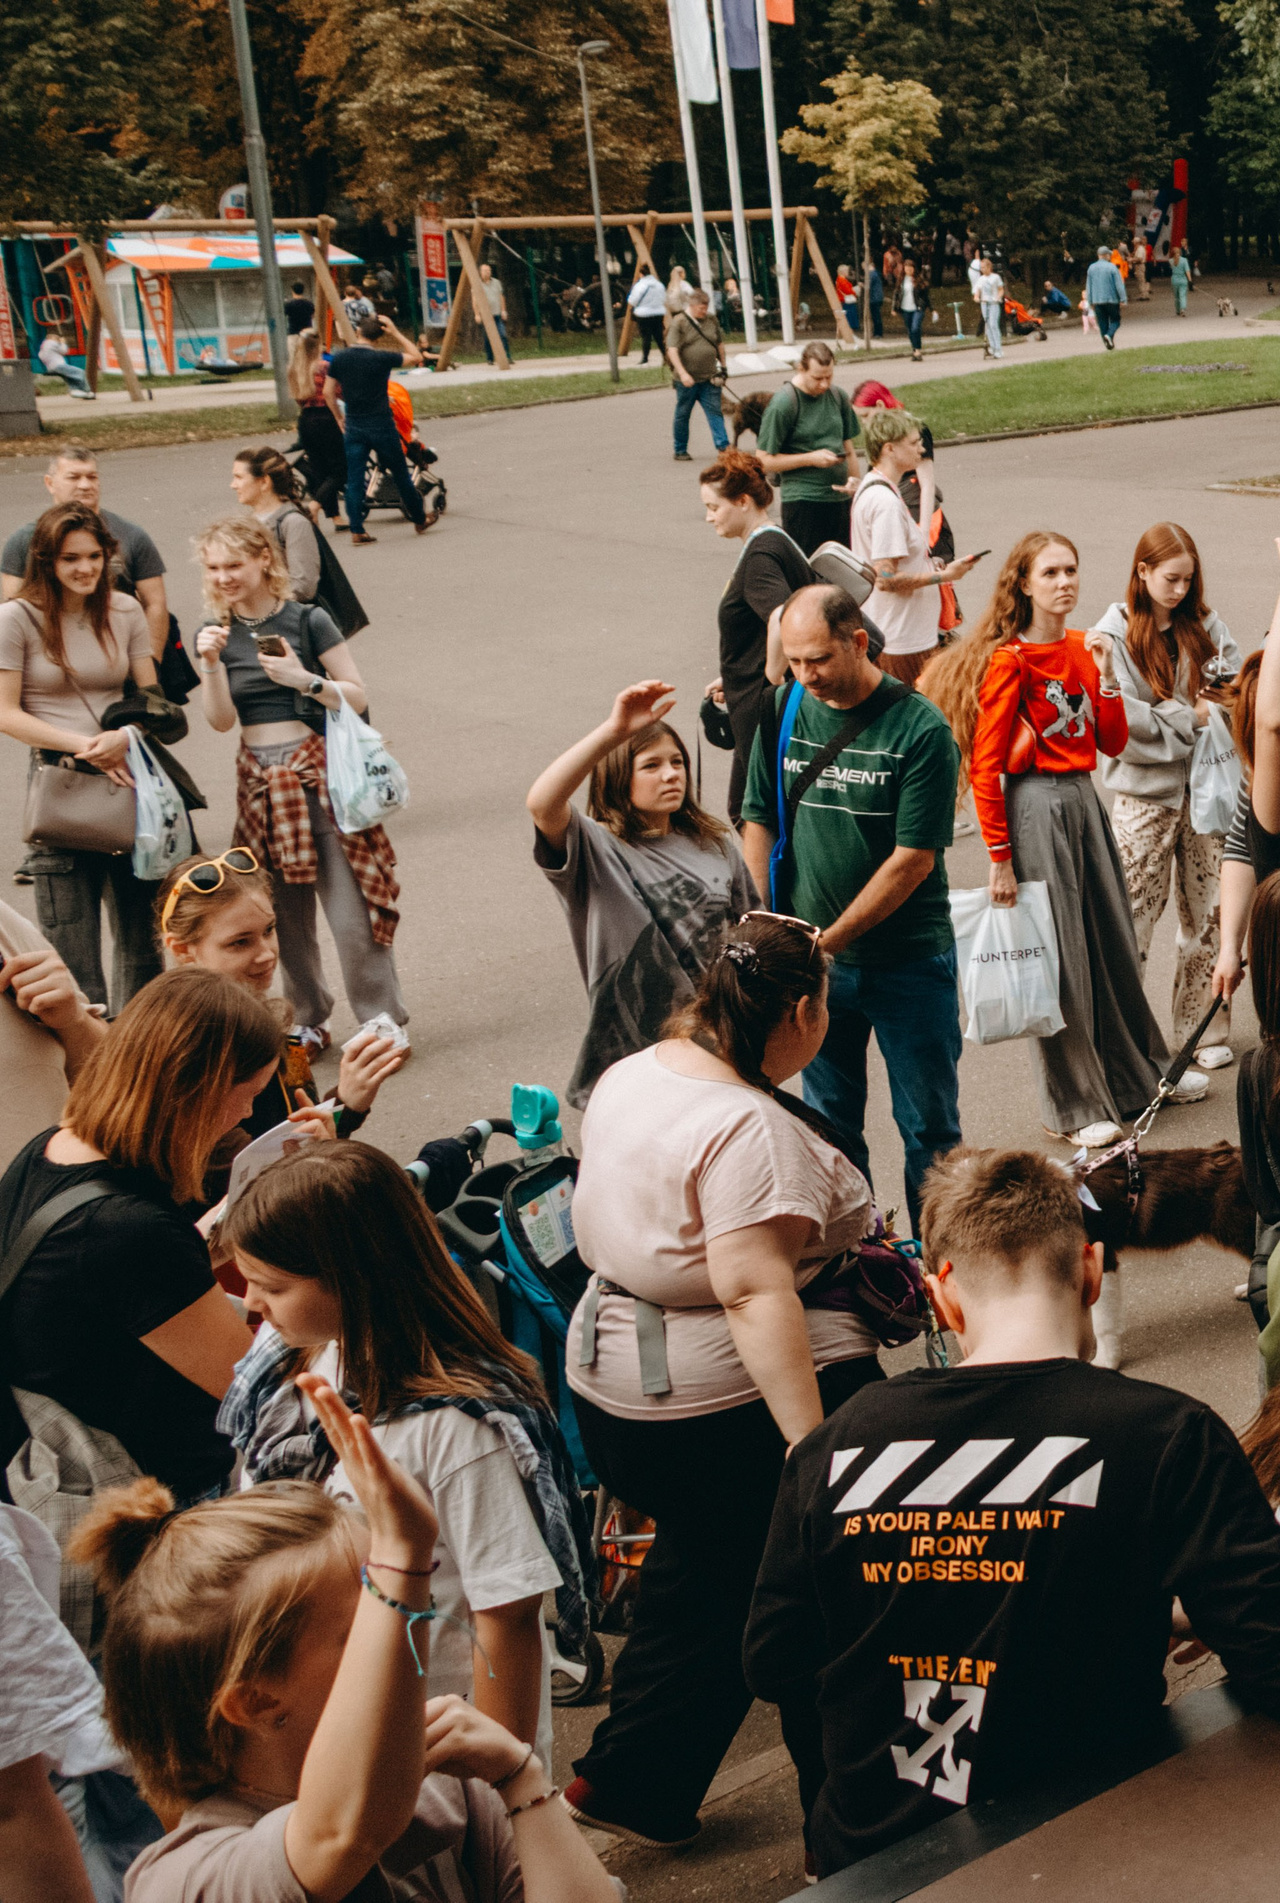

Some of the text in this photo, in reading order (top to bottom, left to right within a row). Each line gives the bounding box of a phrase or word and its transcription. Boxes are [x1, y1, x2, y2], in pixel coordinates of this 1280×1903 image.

[783, 757, 892, 785] MOEMENT
[844, 1514, 862, 1536] IS
[866, 1511, 931, 1533] YOUR
[936, 1510, 994, 1532] PALE
[1002, 1511, 1009, 1531] I
[911, 1535, 989, 1557] IRONY
[862, 1562, 895, 1583] MY
